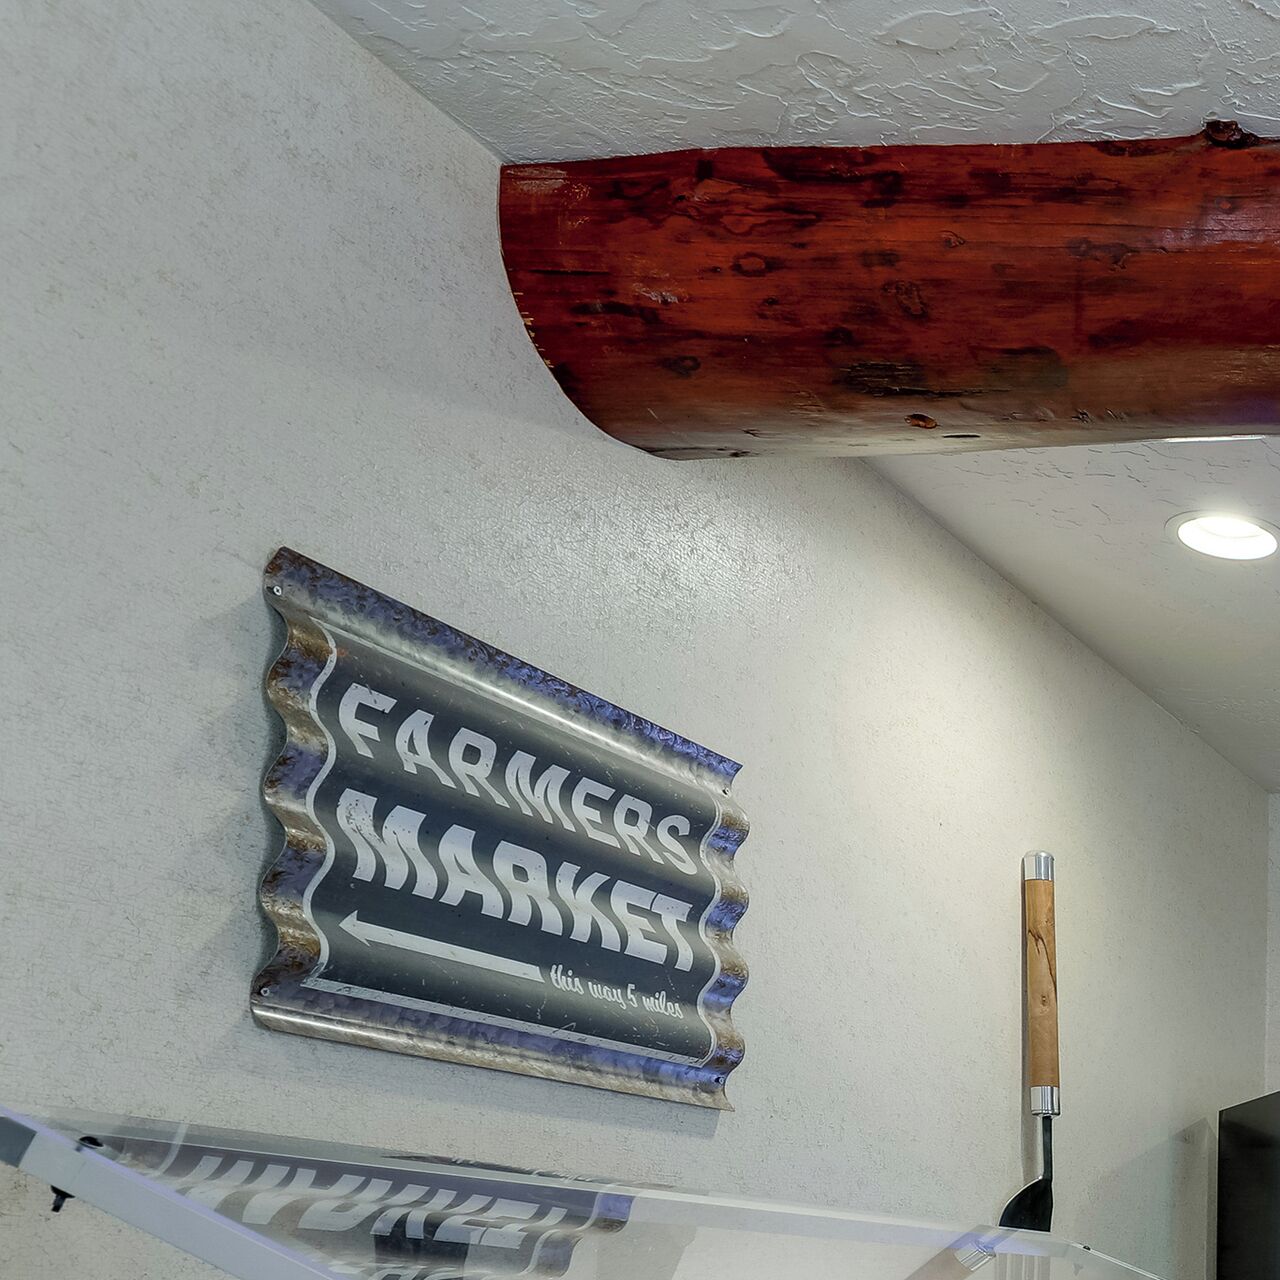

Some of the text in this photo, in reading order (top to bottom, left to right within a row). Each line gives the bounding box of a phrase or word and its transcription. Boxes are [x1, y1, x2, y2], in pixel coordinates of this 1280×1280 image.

[339, 683, 698, 875] FARMERS
[336, 788, 694, 972] MARKET
[550, 964, 684, 1019] this way 5 miles
